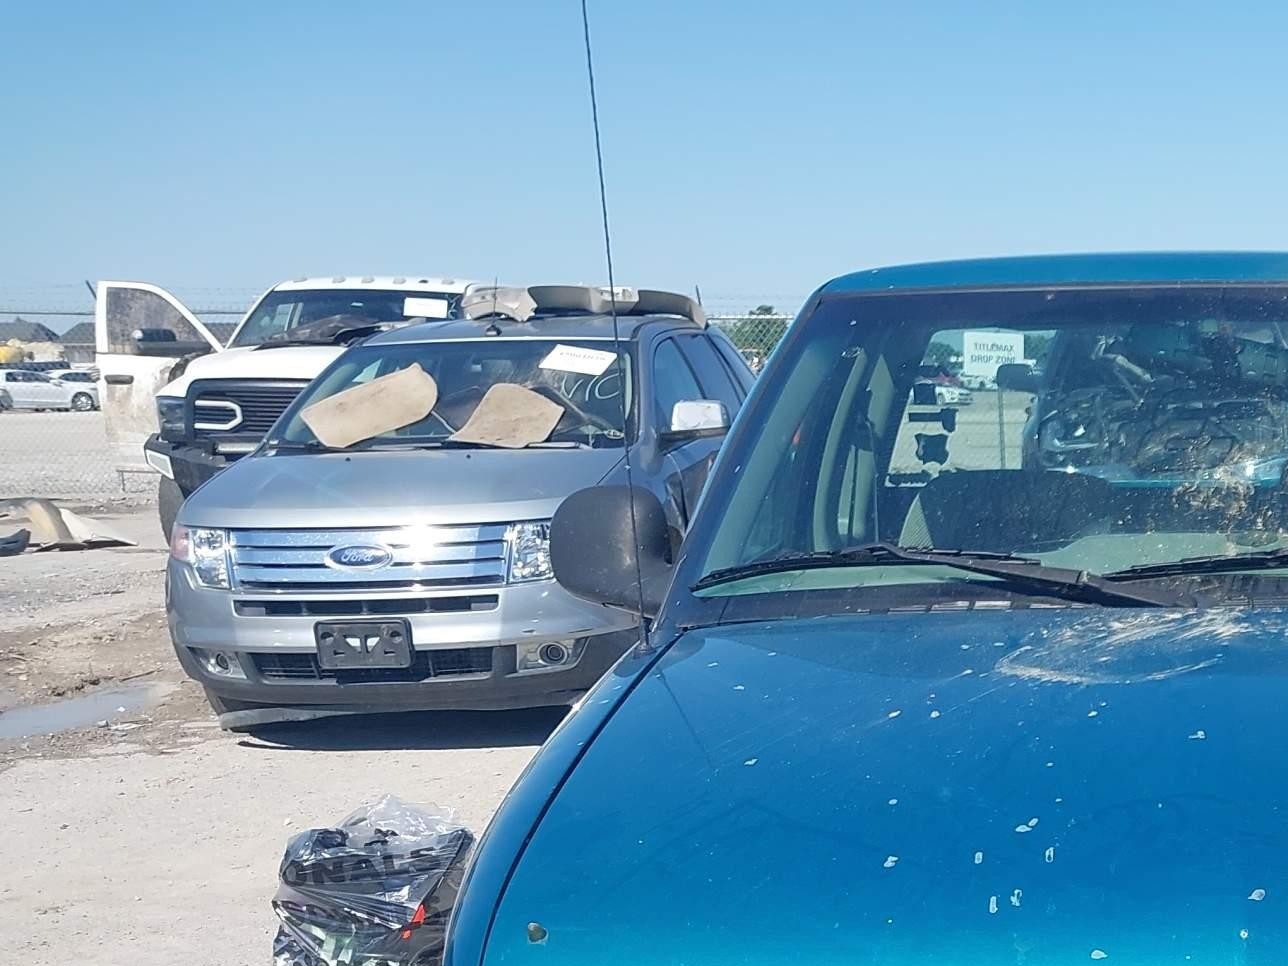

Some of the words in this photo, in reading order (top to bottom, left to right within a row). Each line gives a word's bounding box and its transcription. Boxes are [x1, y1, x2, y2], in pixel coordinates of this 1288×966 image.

[974, 342, 1015, 352] TITLEMAX
[970, 354, 994, 364] DROP
[341, 548, 374, 562] Ford
